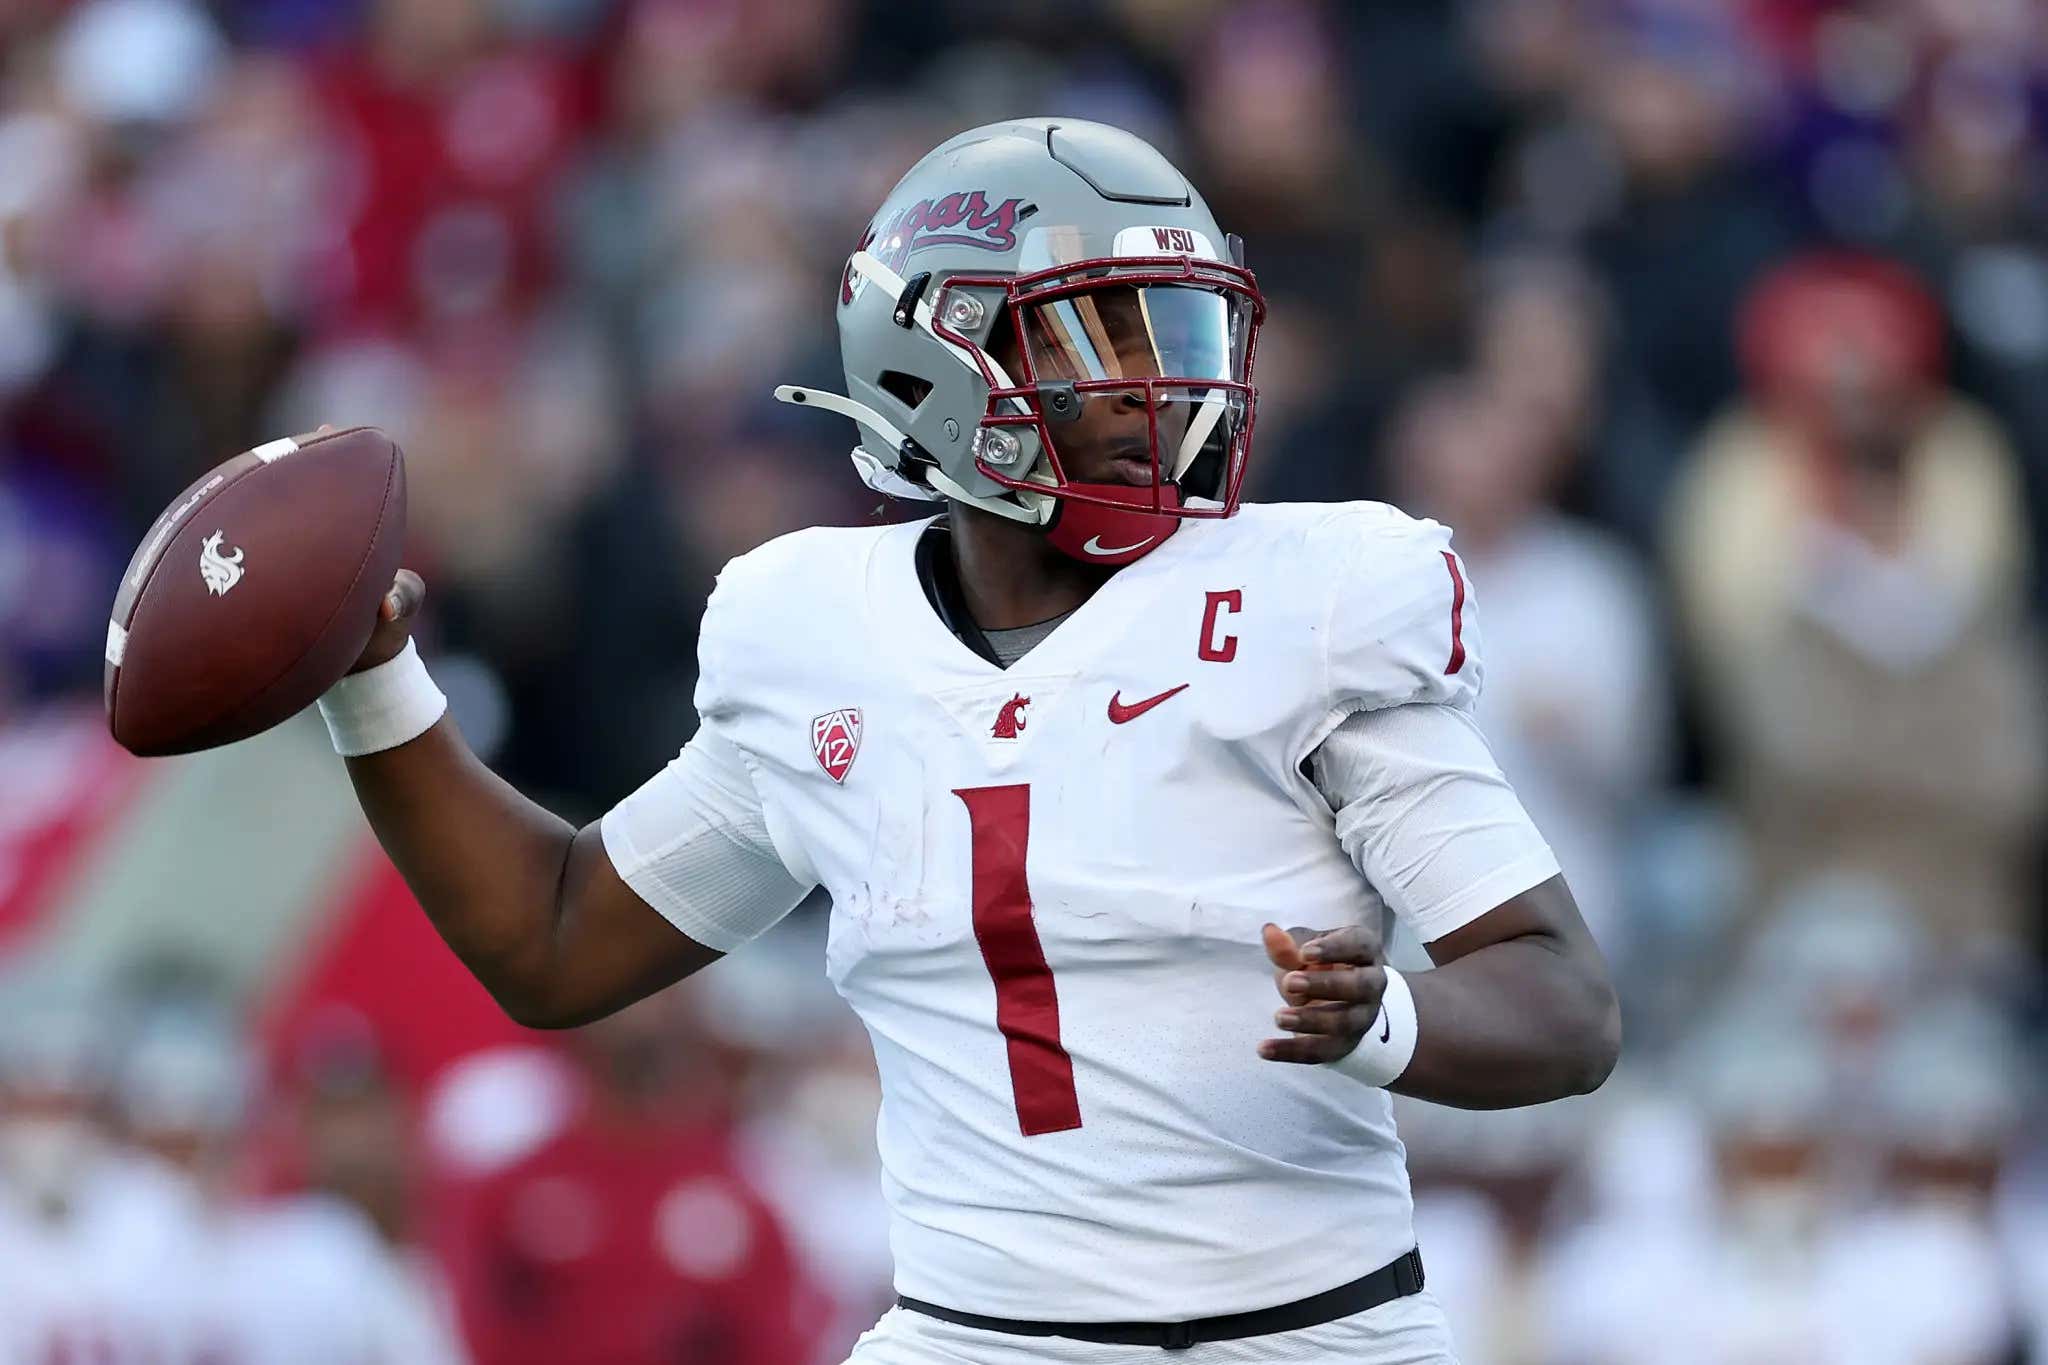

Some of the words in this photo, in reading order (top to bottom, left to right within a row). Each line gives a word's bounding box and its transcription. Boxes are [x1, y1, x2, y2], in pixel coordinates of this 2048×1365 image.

[1152, 228, 1195, 252] WSU
[1198, 589, 1242, 662] C
[1440, 550, 1465, 675] 1
[813, 710, 861, 757] PAC
[824, 738, 850, 768] 12
[951, 783, 1082, 1137] 1
